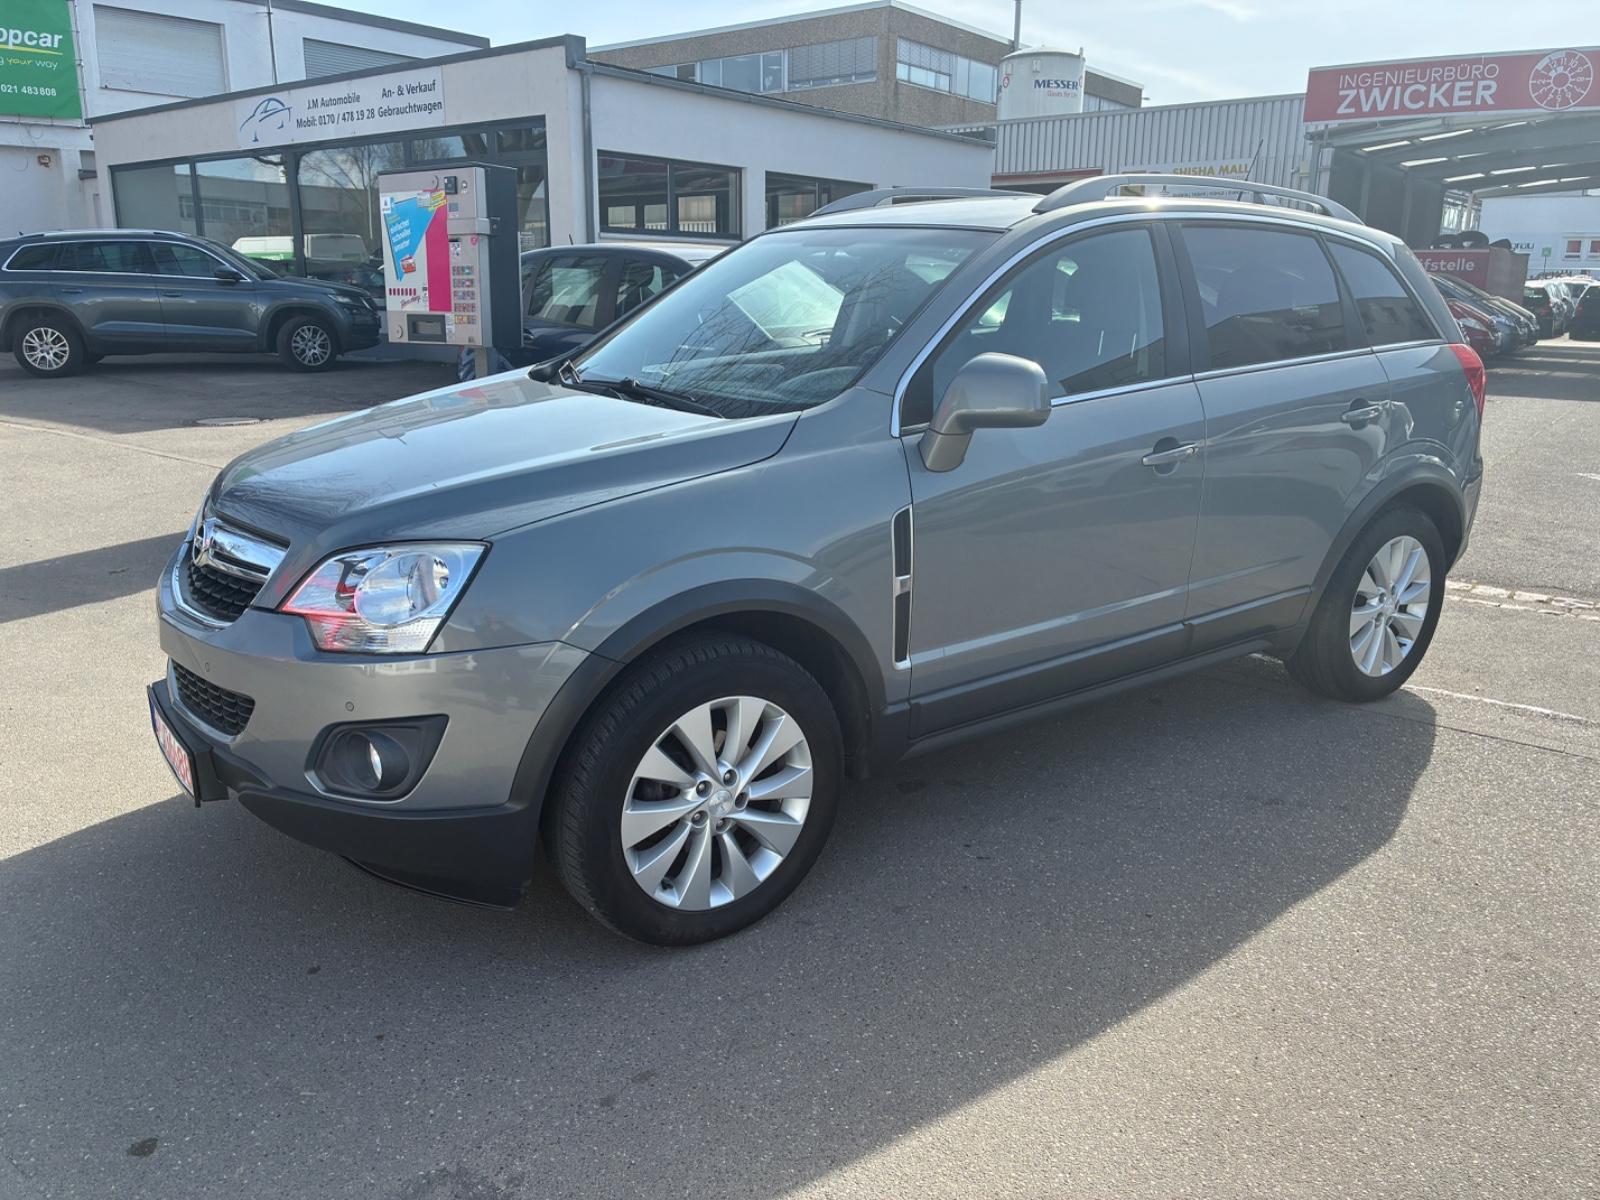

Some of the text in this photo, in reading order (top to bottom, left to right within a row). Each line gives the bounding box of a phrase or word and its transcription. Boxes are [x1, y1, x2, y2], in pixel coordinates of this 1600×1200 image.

[6, 57, 32, 66] your
[35, 60, 58, 71] way
[1033, 79, 1079, 90] MESSER
[1339, 63, 1499, 88] INGENIEURBÜRO
[381, 79, 436, 99] An- & Verkauf
[1337, 80, 1498, 114] ZWICKER
[320, 92, 361, 108] Automobile
[378, 100, 443, 118] Gebrauchtwagen
[296, 117, 318, 129] Mobil:
[318, 114, 335, 126] 0170
[341, 111, 355, 123] 478
[356, 109, 365, 121] 19
[366, 108, 375, 120] 28
[1172, 163, 1249, 175] SHISHA MALL
